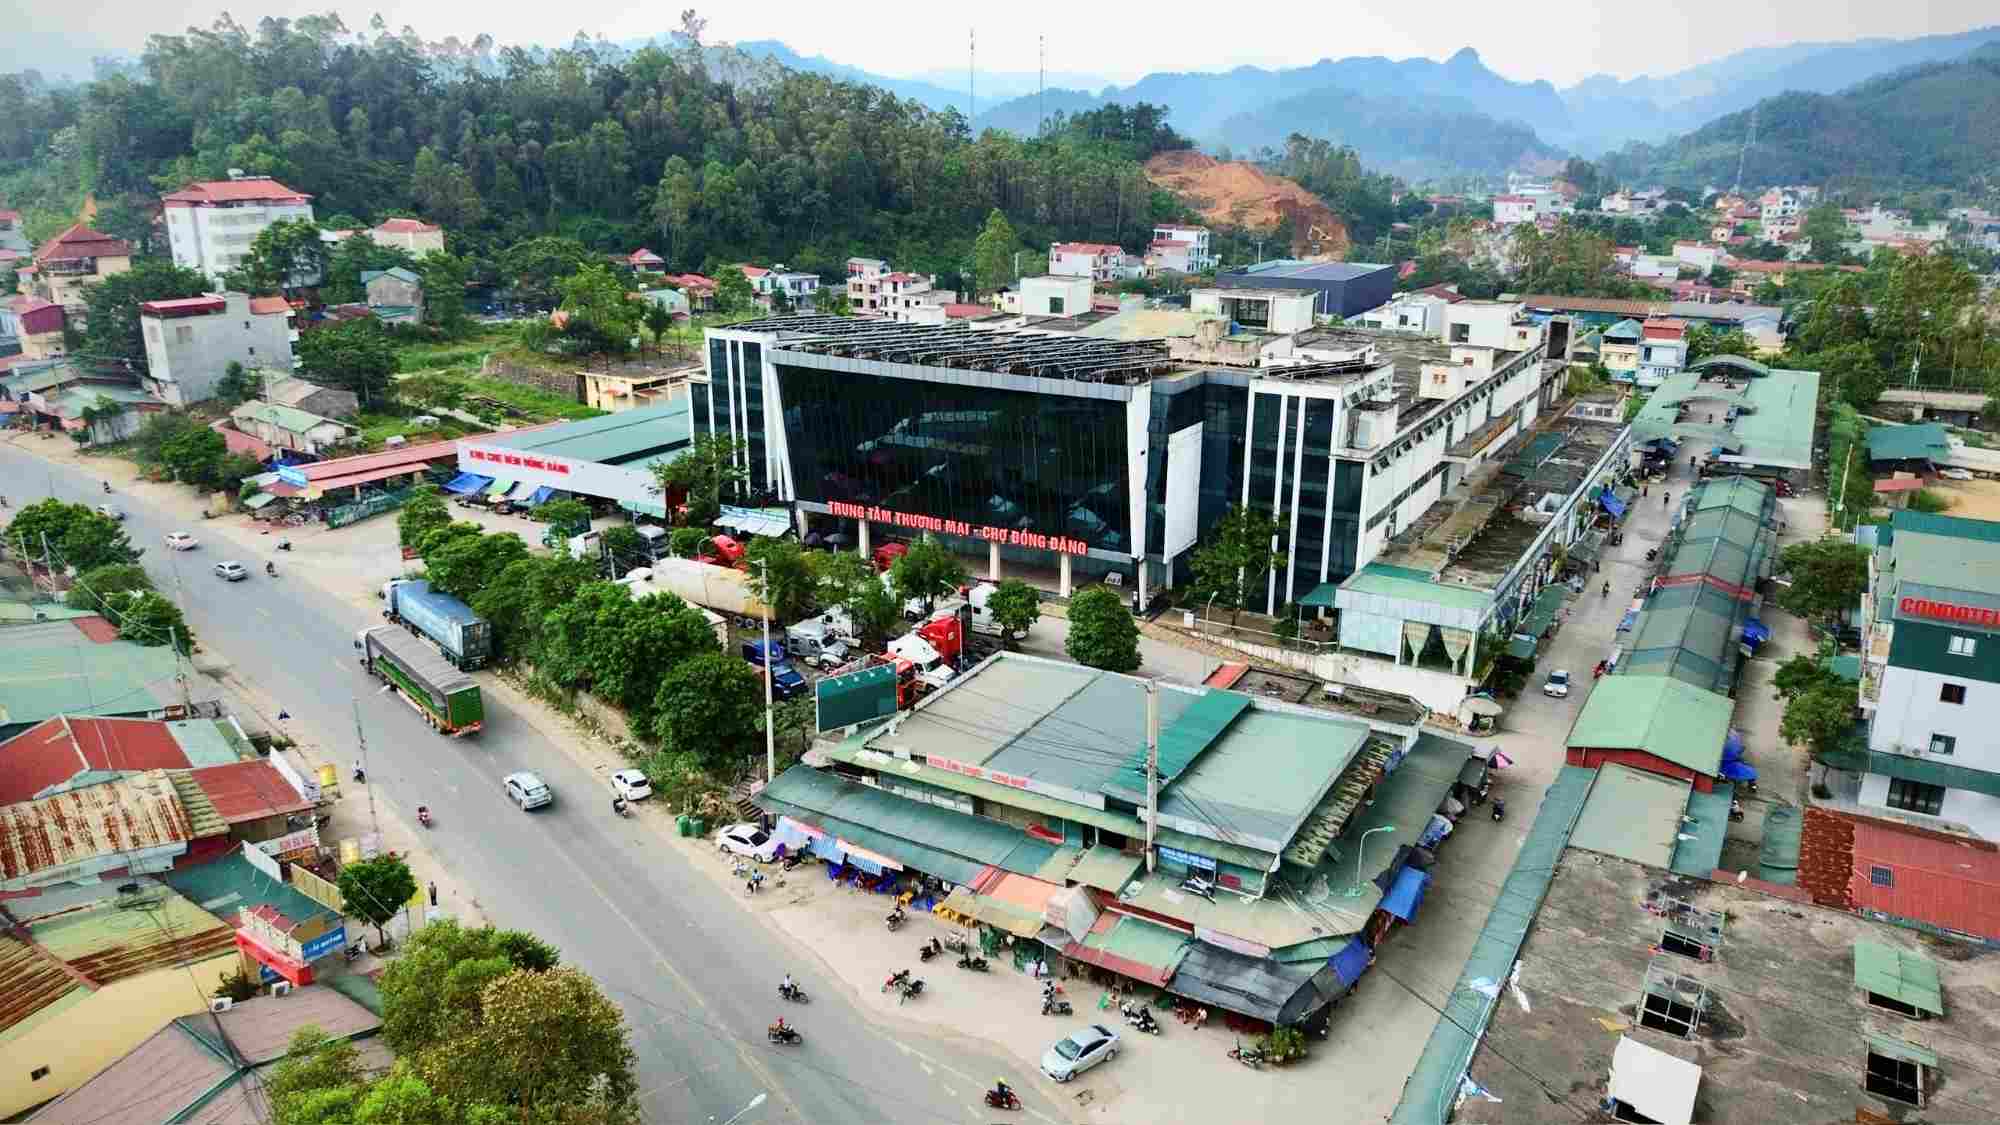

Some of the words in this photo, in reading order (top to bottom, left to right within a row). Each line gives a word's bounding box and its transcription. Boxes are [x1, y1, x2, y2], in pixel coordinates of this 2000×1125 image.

[828, 501, 865, 519] TRUNG
[868, 506, 892, 524] TÂM
[895, 512, 942, 531] THƯƠNG
[945, 520, 970, 536] MẠI
[982, 526, 1008, 541] CHỢ
[1011, 528, 1047, 549] ĐỒNG
[1049, 535, 1087, 555] ĐĂNG
